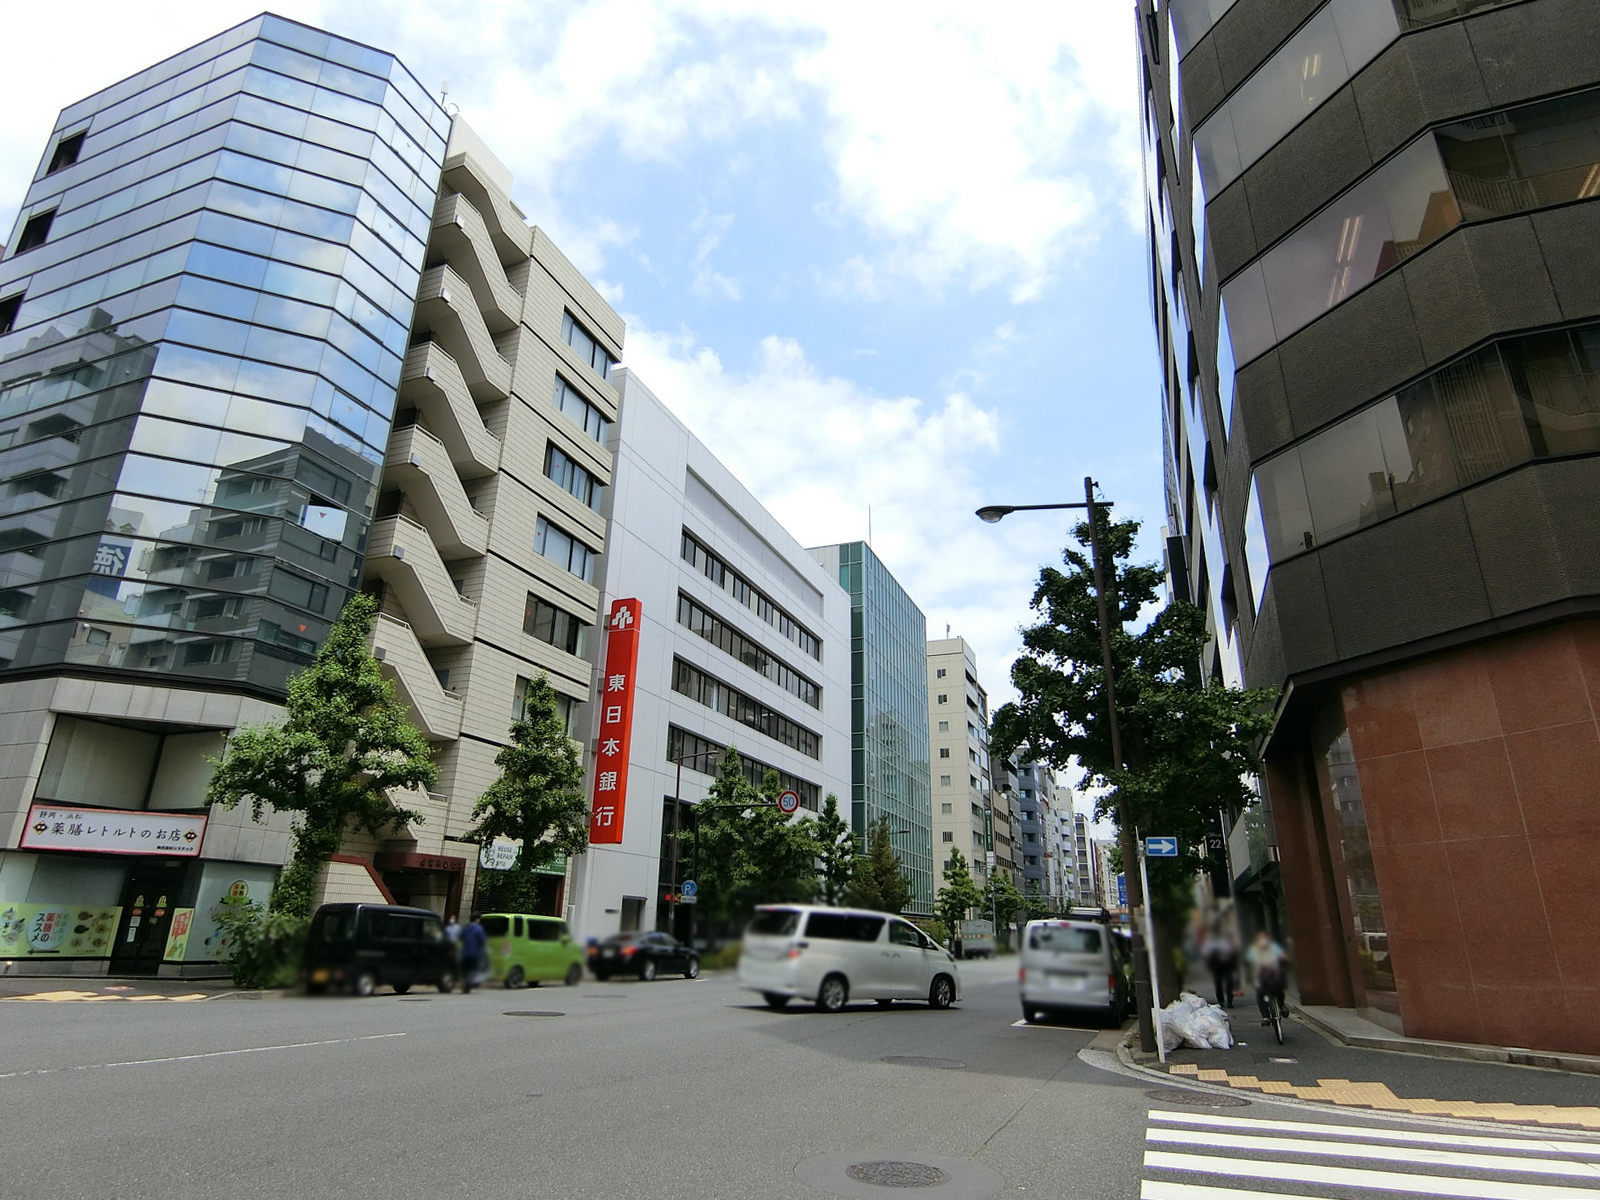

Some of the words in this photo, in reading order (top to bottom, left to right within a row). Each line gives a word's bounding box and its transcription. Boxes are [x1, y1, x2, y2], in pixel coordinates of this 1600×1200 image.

[595, 674, 626, 827] 東日本銀行
[783, 797, 795, 807] 50
[51, 822, 181, 842] 薬膳レトルトのお店
[1209, 839, 1222, 848] 22
[498, 845, 512, 853] REUSE
